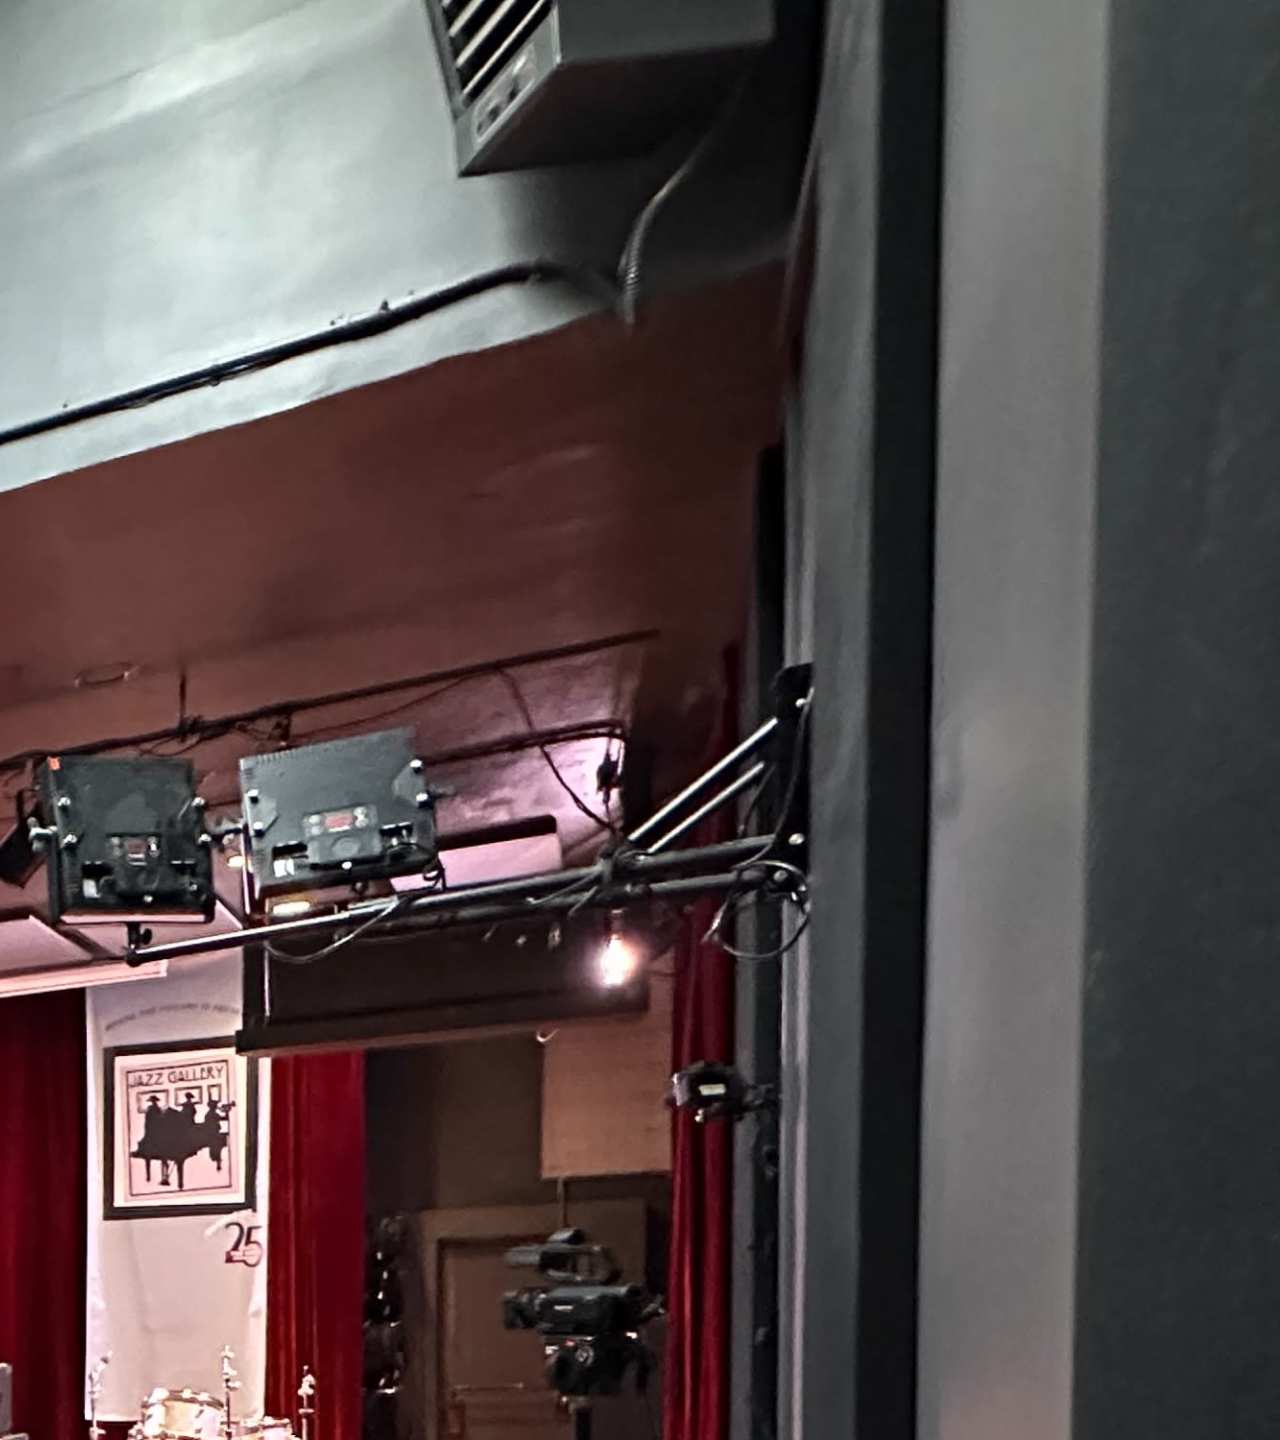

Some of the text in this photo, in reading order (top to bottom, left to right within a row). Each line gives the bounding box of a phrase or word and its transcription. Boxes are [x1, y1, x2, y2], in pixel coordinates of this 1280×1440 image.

[128, 1065, 225, 1089] JAZZ GALLERY
[225, 1221, 263, 1268] 25
